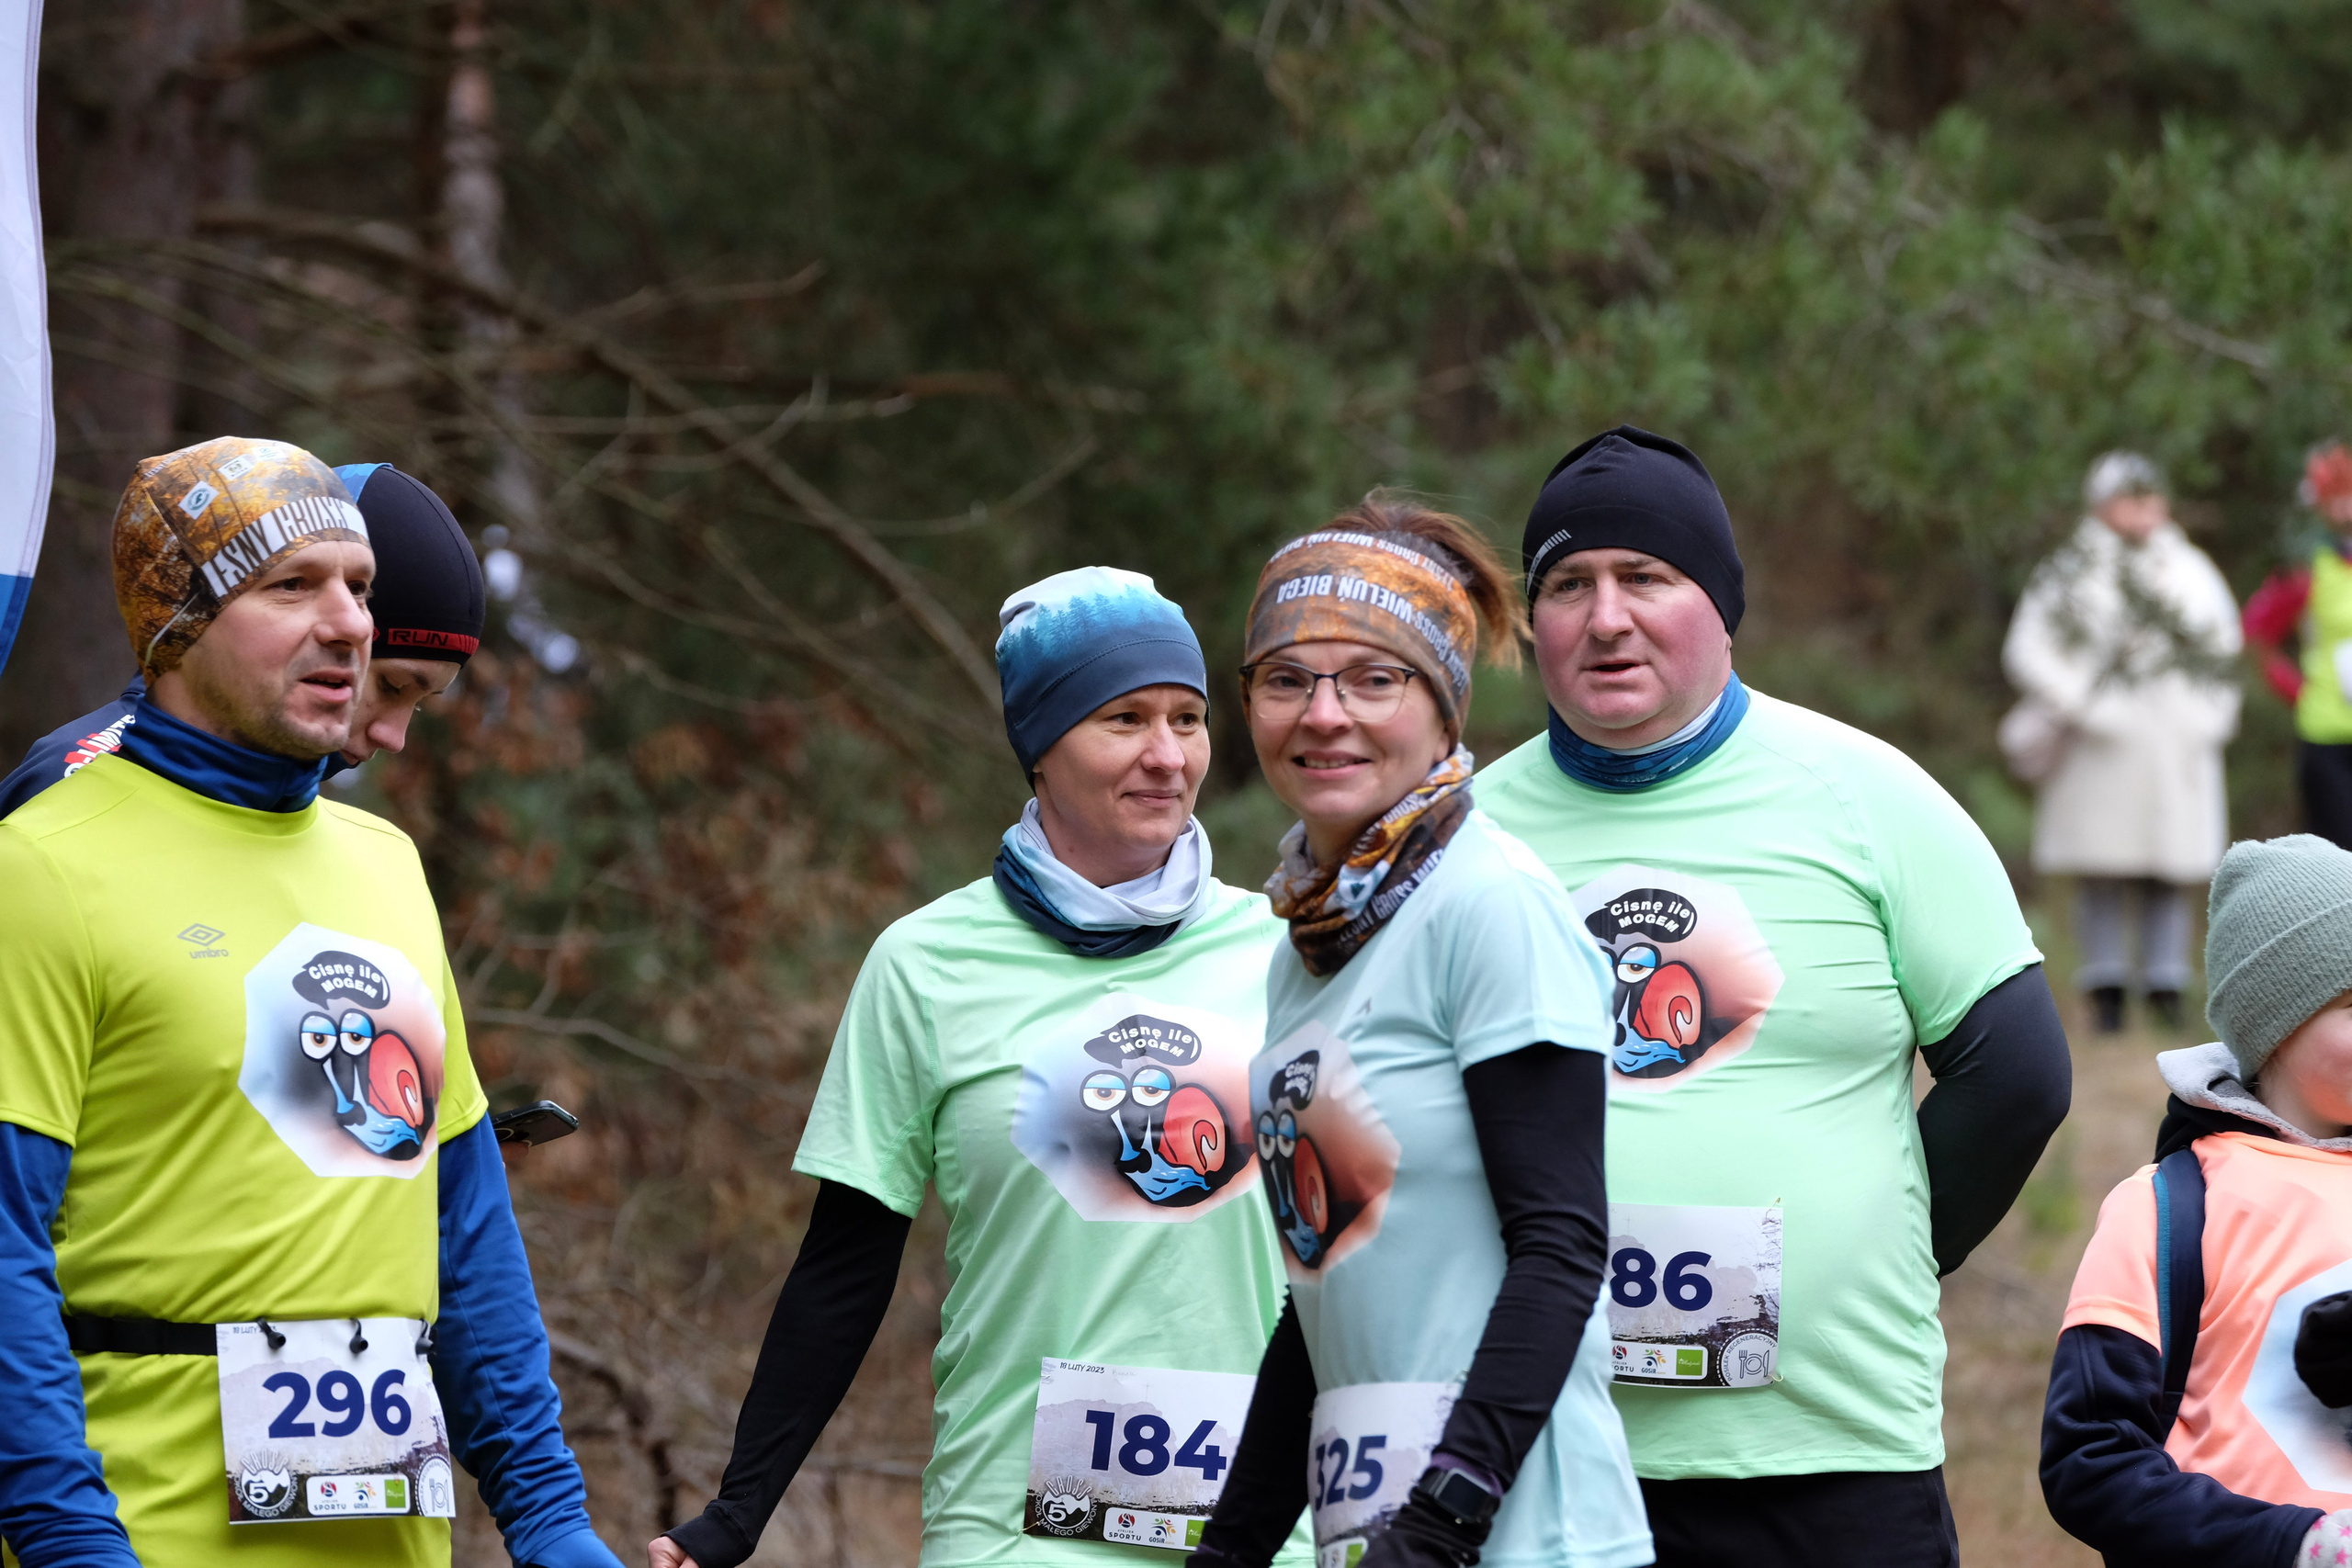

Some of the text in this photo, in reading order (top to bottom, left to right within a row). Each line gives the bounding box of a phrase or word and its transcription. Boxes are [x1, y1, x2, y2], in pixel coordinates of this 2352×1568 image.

[1276, 575, 1333, 604] BIEGA
[1337, 575, 1413, 625] WIELUŃ
[392, 630, 448, 646] RUN
[1610, 900, 1690, 919] Cisnę ile
[1618, 913, 1679, 933] MOGEM
[189, 947, 229, 959] umbro
[309, 964, 381, 983] Cisnę ile
[321, 977, 378, 998] MOGEM
[1108, 1025, 1193, 1045] Cisnę ile
[1119, 1039, 1185, 1057] MOGEM
[1727, 1335, 1778, 1355] REGENERACYJNY
[1068, 1362, 1085, 1371] LUTY
[1086, 1365, 1105, 1374] 2023
[262, 1369, 412, 1438] 296
[1085, 1409, 1227, 1481] 184
[249, 1482, 269, 1504] 5
[1046, 1475, 1092, 1499] CROSS
[313, 1503, 346, 1511] SPORTU
[1047, 1504, 1067, 1522] 5
[1108, 1531, 1142, 1541] SPORTU
